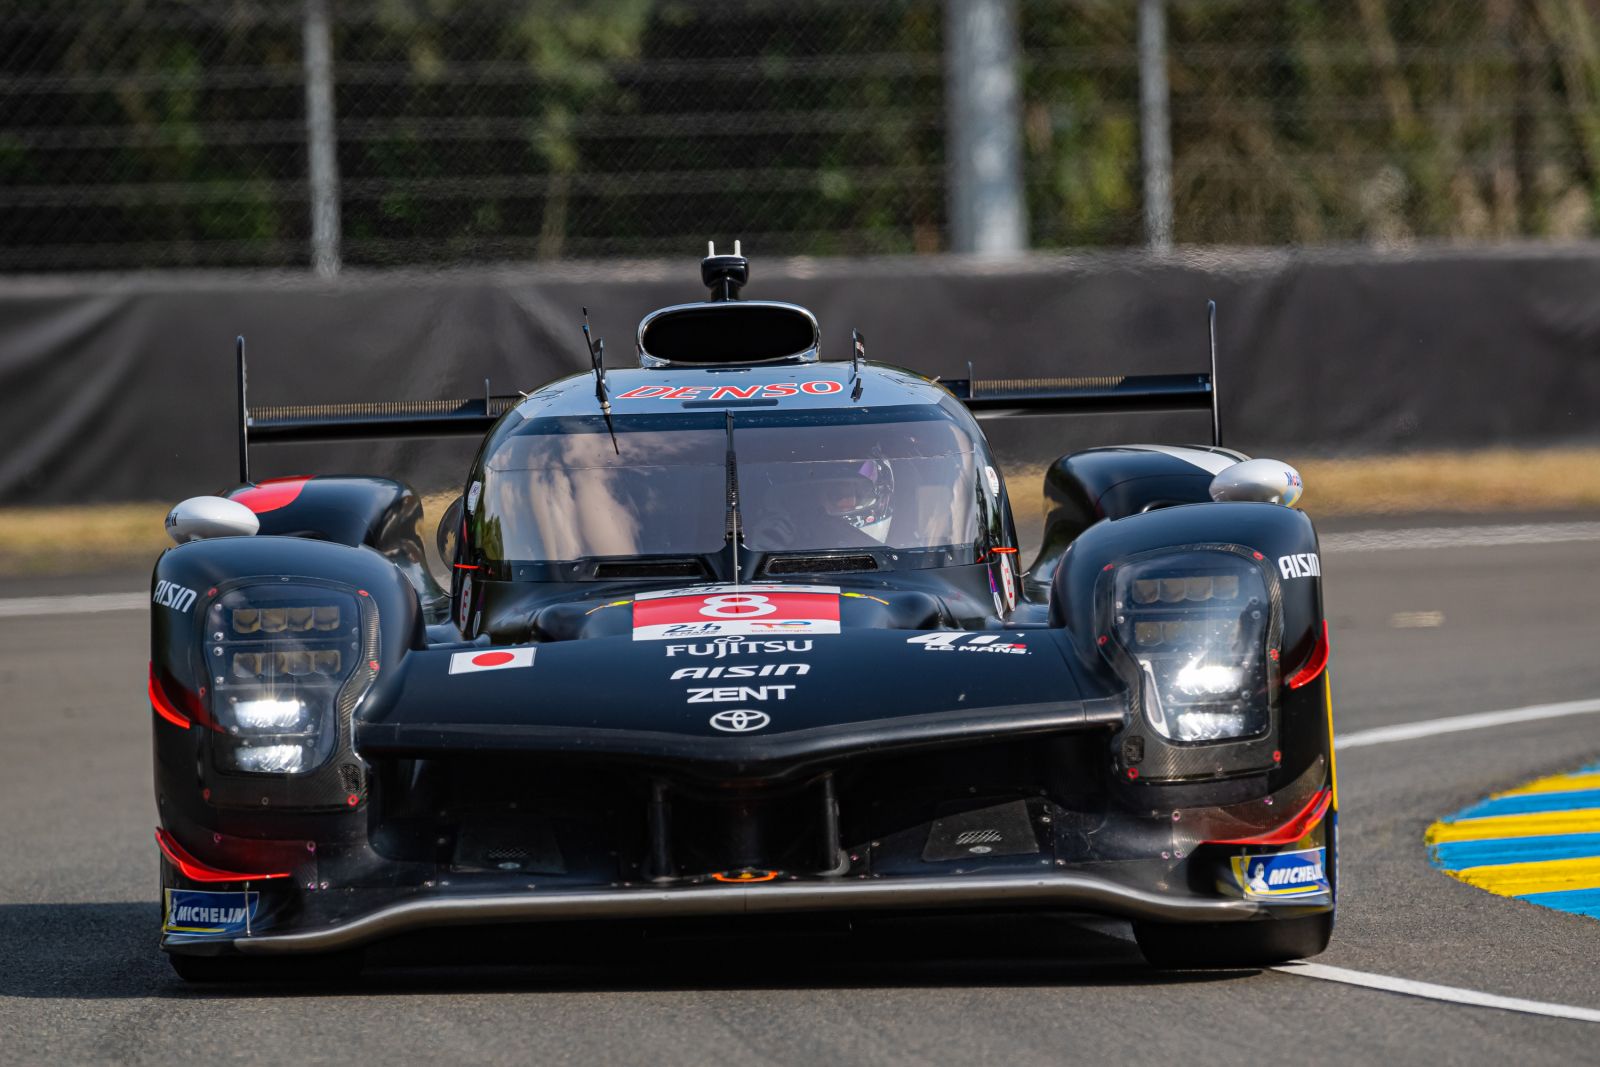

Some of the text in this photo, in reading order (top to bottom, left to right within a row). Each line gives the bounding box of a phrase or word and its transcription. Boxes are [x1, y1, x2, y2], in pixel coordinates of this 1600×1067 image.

[615, 380, 843, 400] DENSO
[152, 580, 197, 613] AISIN
[698, 594, 777, 618] 8
[665, 637, 813, 659] FUJITSU
[670, 663, 811, 680] AISIN
[686, 685, 796, 703] ZENT
[177, 906, 247, 923] MICHELIN
